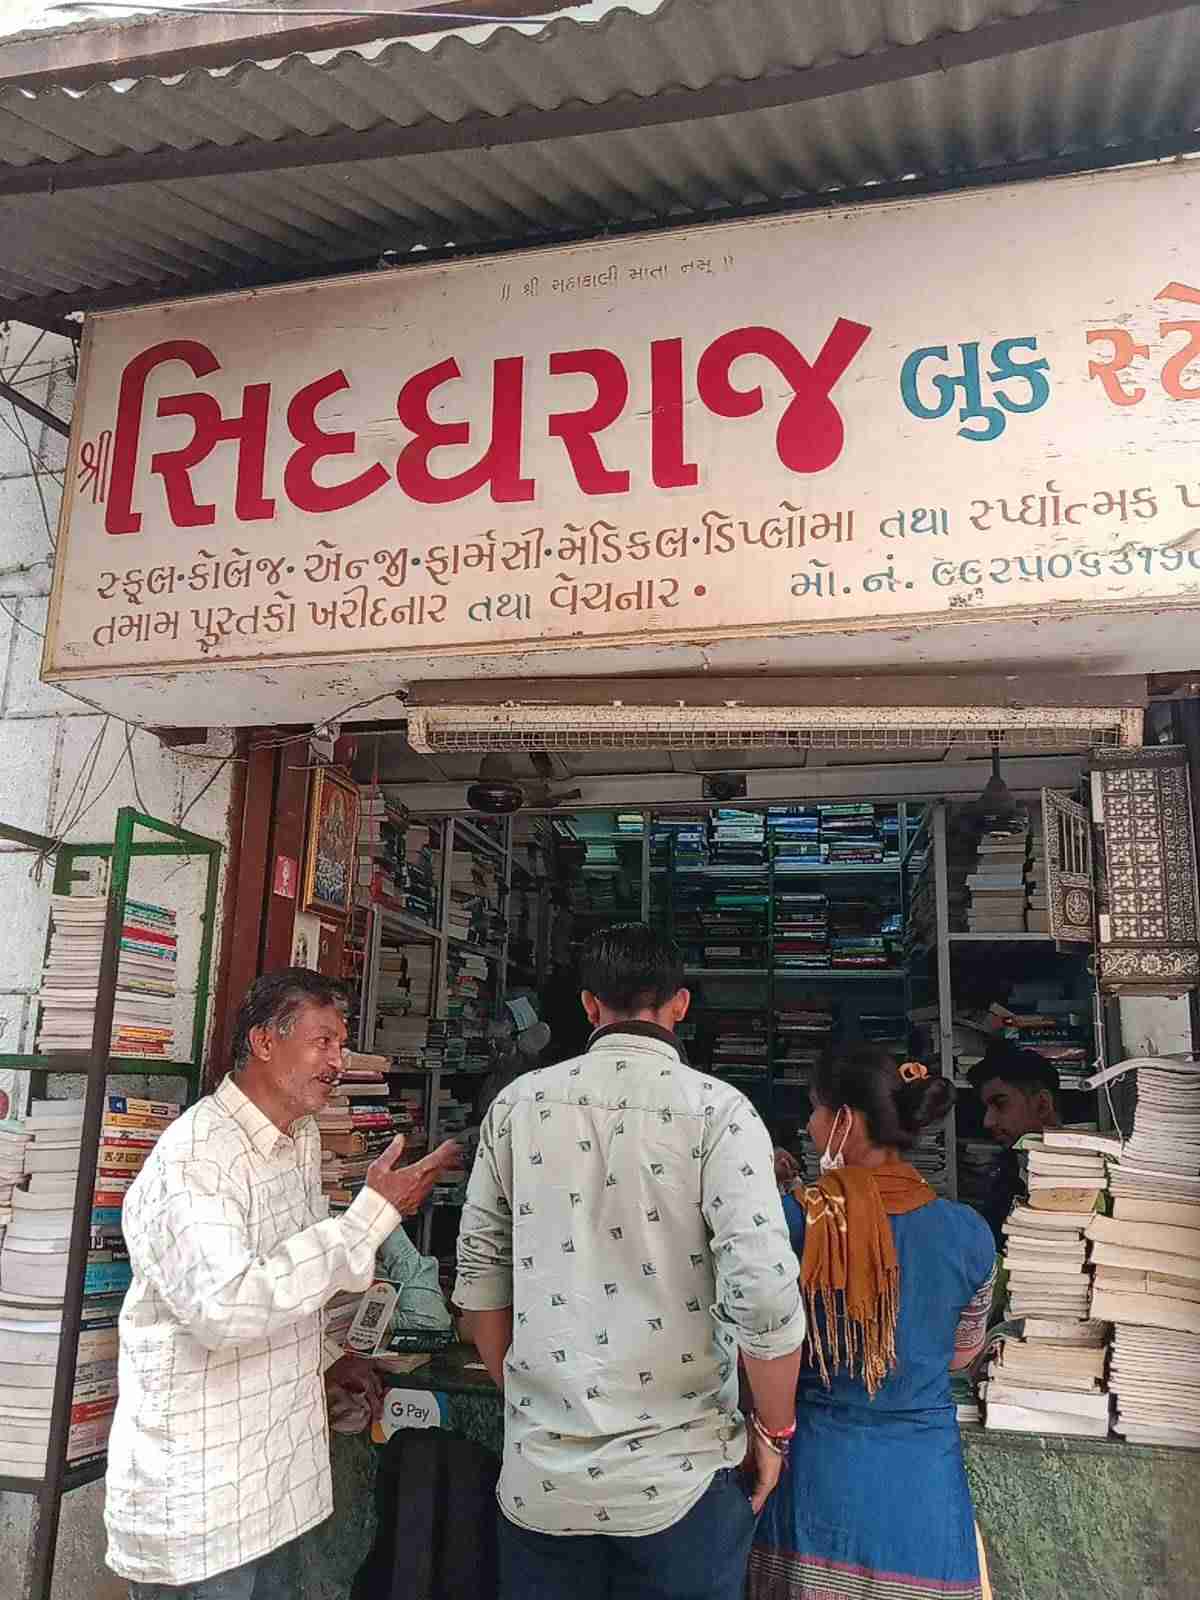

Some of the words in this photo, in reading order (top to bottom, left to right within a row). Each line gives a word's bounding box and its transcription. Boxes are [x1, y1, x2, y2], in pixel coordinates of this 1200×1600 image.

[78, 430, 112, 504] શ્રી
[900, 336, 1051, 442] બુક
[879, 507, 950, 538] તથા
[92, 609, 179, 647] તમામ
[307, 585, 447, 631] ખરીદનાર
[468, 593, 531, 622] તથા
[549, 573, 679, 615] વેચનાર
[407, 1403, 430, 1423] Pay
